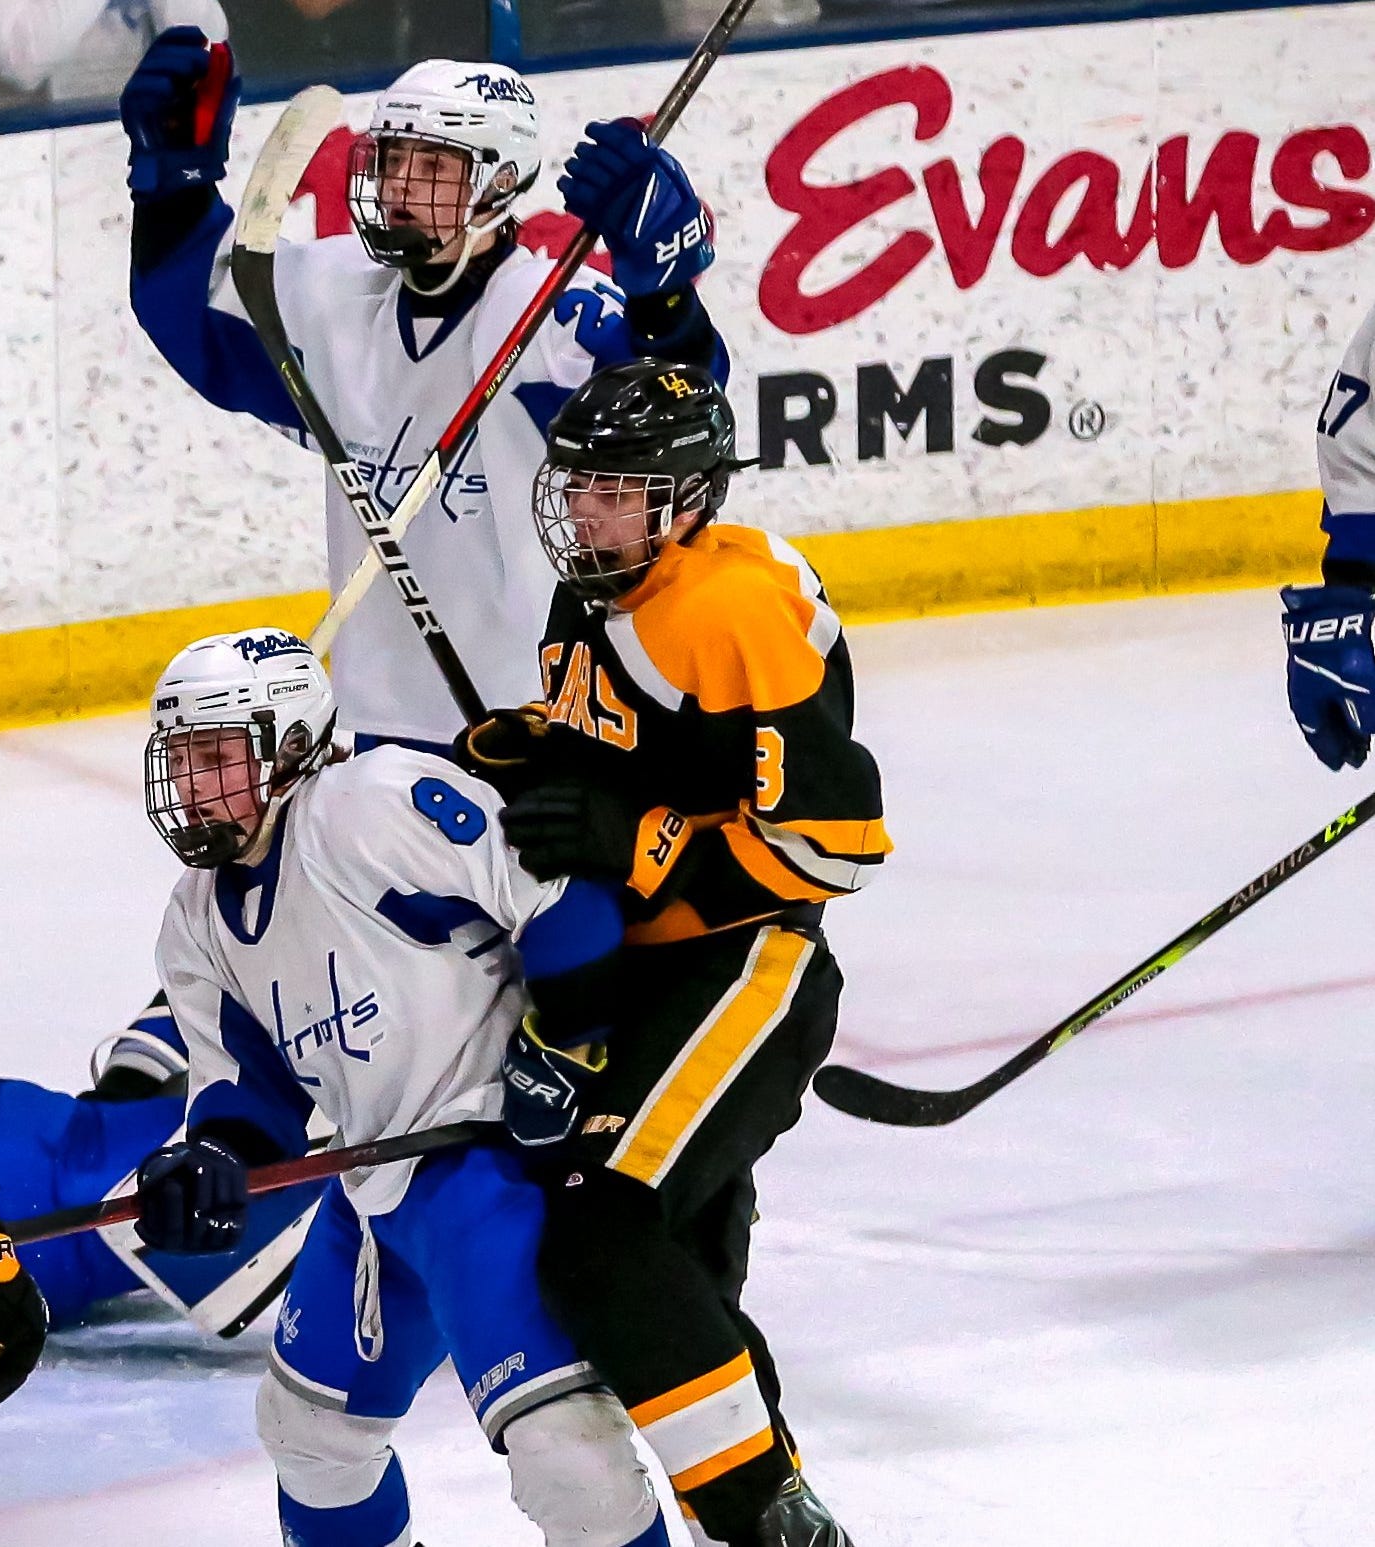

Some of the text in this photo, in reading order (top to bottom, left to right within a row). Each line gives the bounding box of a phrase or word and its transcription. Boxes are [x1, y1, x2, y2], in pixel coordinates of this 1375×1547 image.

[758, 64, 1375, 334] Evans
[758, 348, 1052, 470] RMS
[332, 461, 447, 638] BAUER
[1282, 613, 1364, 644] UER
[411, 777, 487, 845] 8
[1229, 842, 1315, 913] ALPHA
